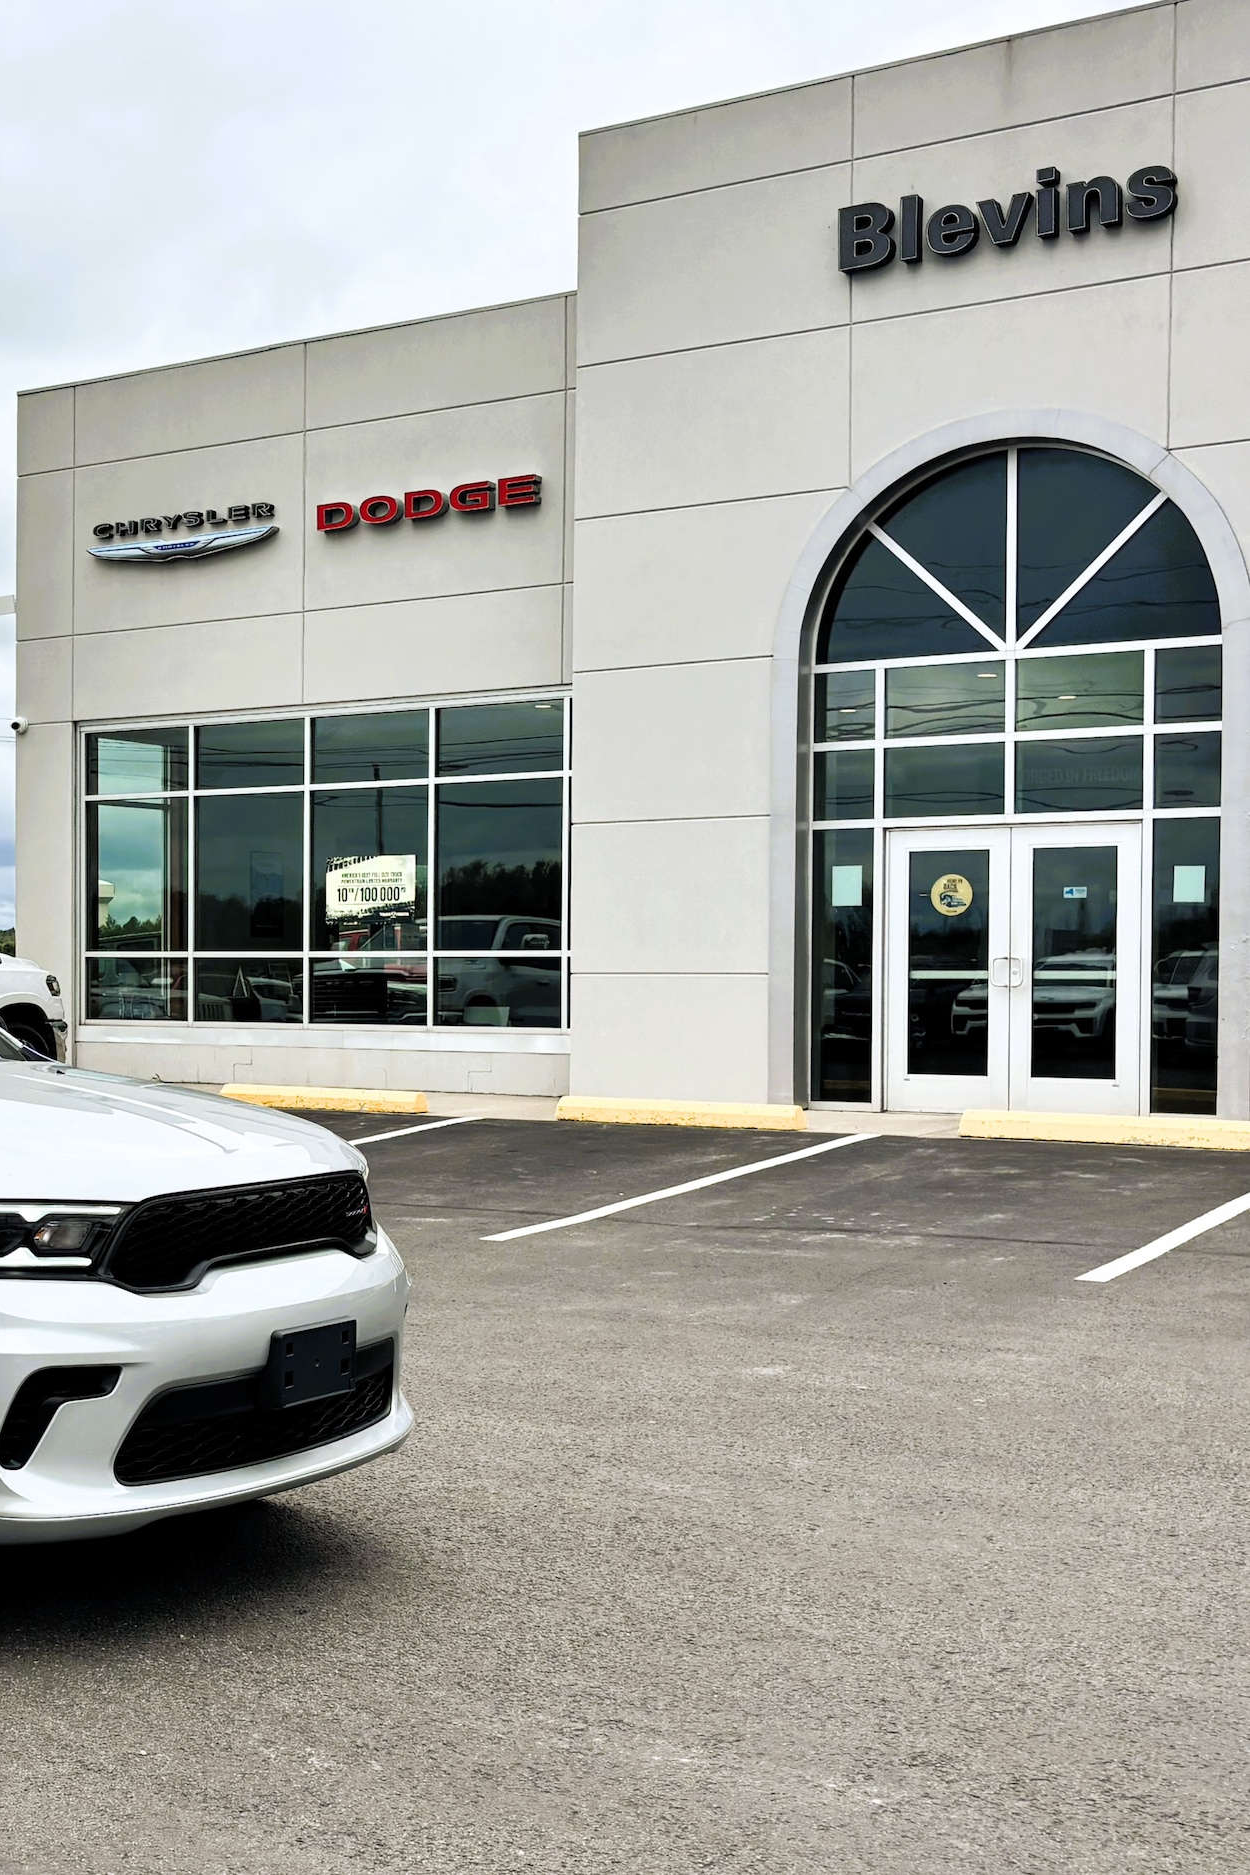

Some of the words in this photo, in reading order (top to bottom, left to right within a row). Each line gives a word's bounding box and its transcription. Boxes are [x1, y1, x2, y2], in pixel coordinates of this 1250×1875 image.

[838, 165, 1177, 274] Blevins
[93, 502, 275, 539] CHRYSLER
[317, 474, 542, 532] DODGE
[1022, 767, 1063, 785] ORGED
[1065, 767, 1079, 784] IN
[1082, 765, 1142, 783] FREEDOM
